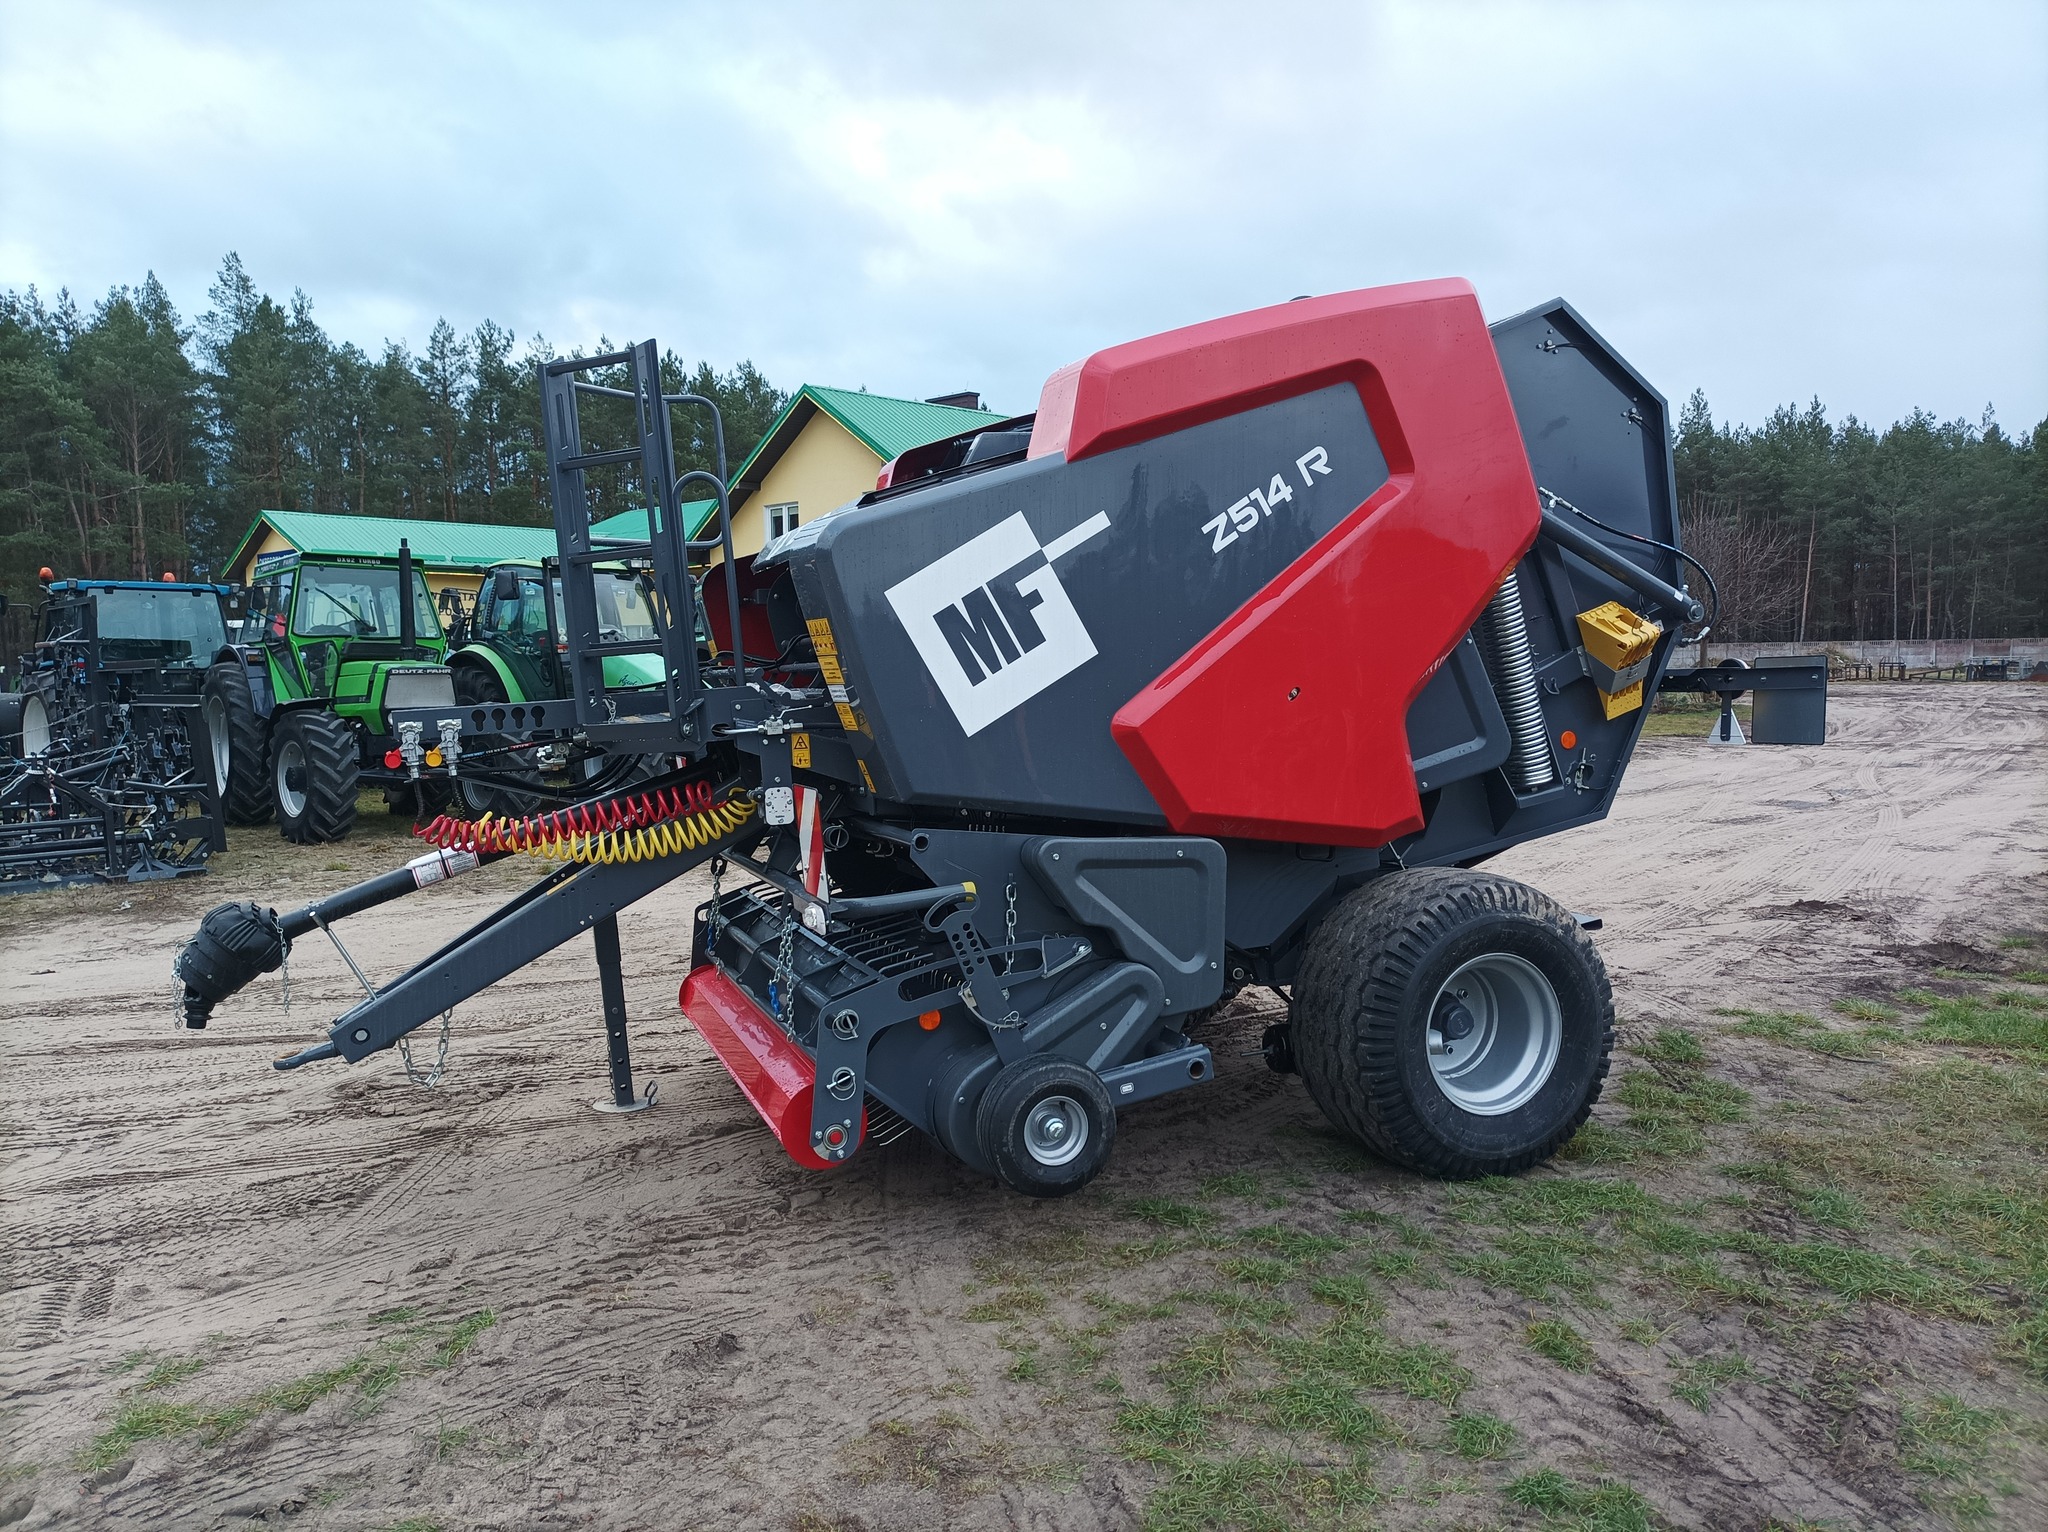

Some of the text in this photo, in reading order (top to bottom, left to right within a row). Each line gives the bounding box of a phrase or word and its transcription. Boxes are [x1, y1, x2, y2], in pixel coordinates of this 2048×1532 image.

[1201, 446, 1333, 554] Z514 R
[932, 549, 1048, 687] MF
